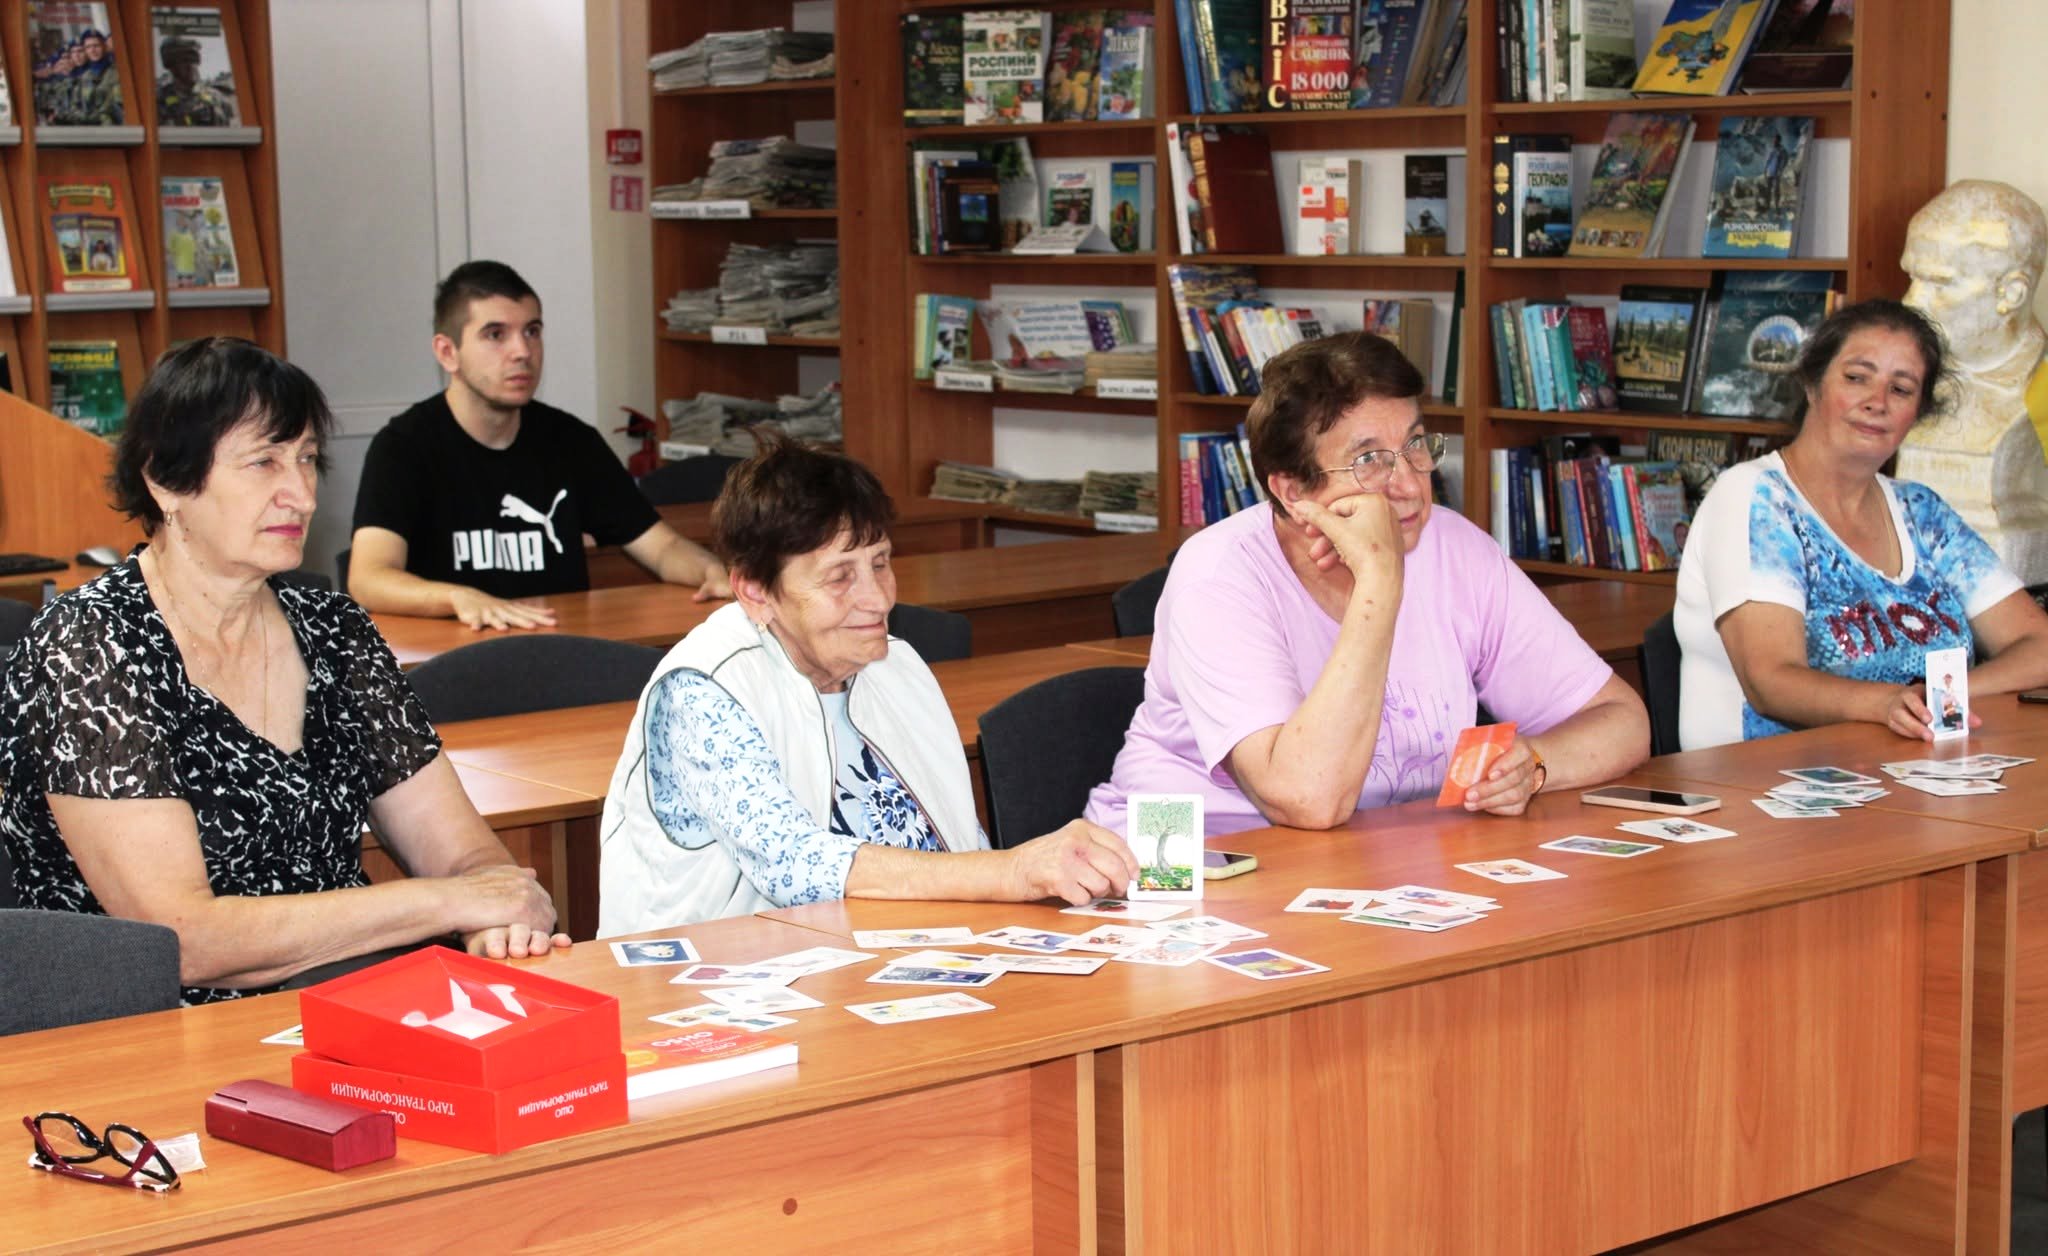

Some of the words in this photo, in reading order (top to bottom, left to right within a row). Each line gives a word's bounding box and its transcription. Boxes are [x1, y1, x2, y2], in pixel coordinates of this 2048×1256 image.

[1291, 71, 1308, 90] 18
[1311, 70, 1349, 90] 000
[651, 1031, 713, 1047] OSHO
[589, 1080, 609, 1093] ТАРО
[330, 1082, 426, 1111] ТРАНСФОРМАЦИИ
[518, 1087, 589, 1116] ТРАНСФОРМАЦИИ
[428, 1099, 456, 1116] ТАРО
[554, 1105, 574, 1118] ОШО
[380, 1109, 406, 1124] ОШ
